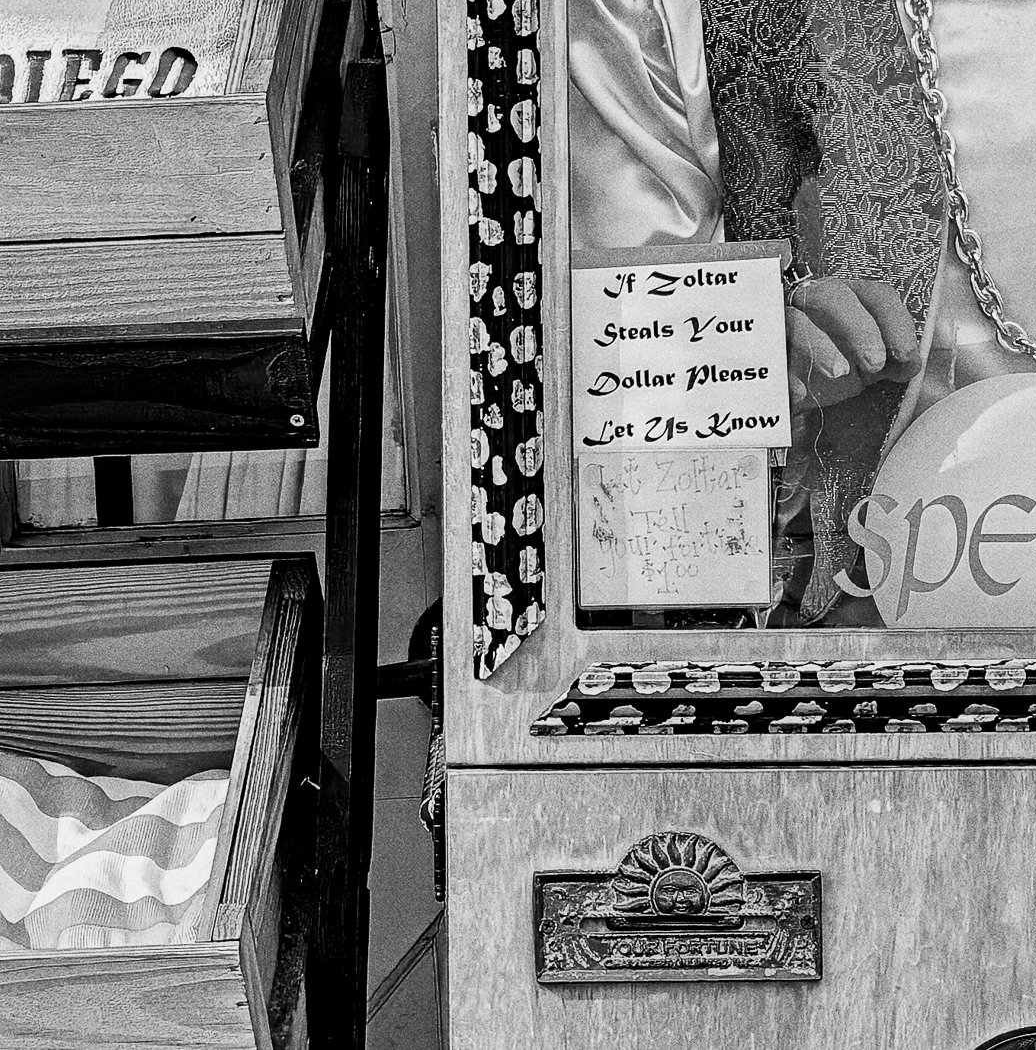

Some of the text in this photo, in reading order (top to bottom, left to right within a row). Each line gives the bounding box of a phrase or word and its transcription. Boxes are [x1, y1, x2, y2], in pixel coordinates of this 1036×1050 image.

[602, 268, 739, 299] If Zoltar
[593, 315, 755, 348] Steals Your
[586, 364, 769, 397] Dollar Please
[582, 411, 781, 447] Let Us Know
[663, 938, 758, 956] FORTUNE
